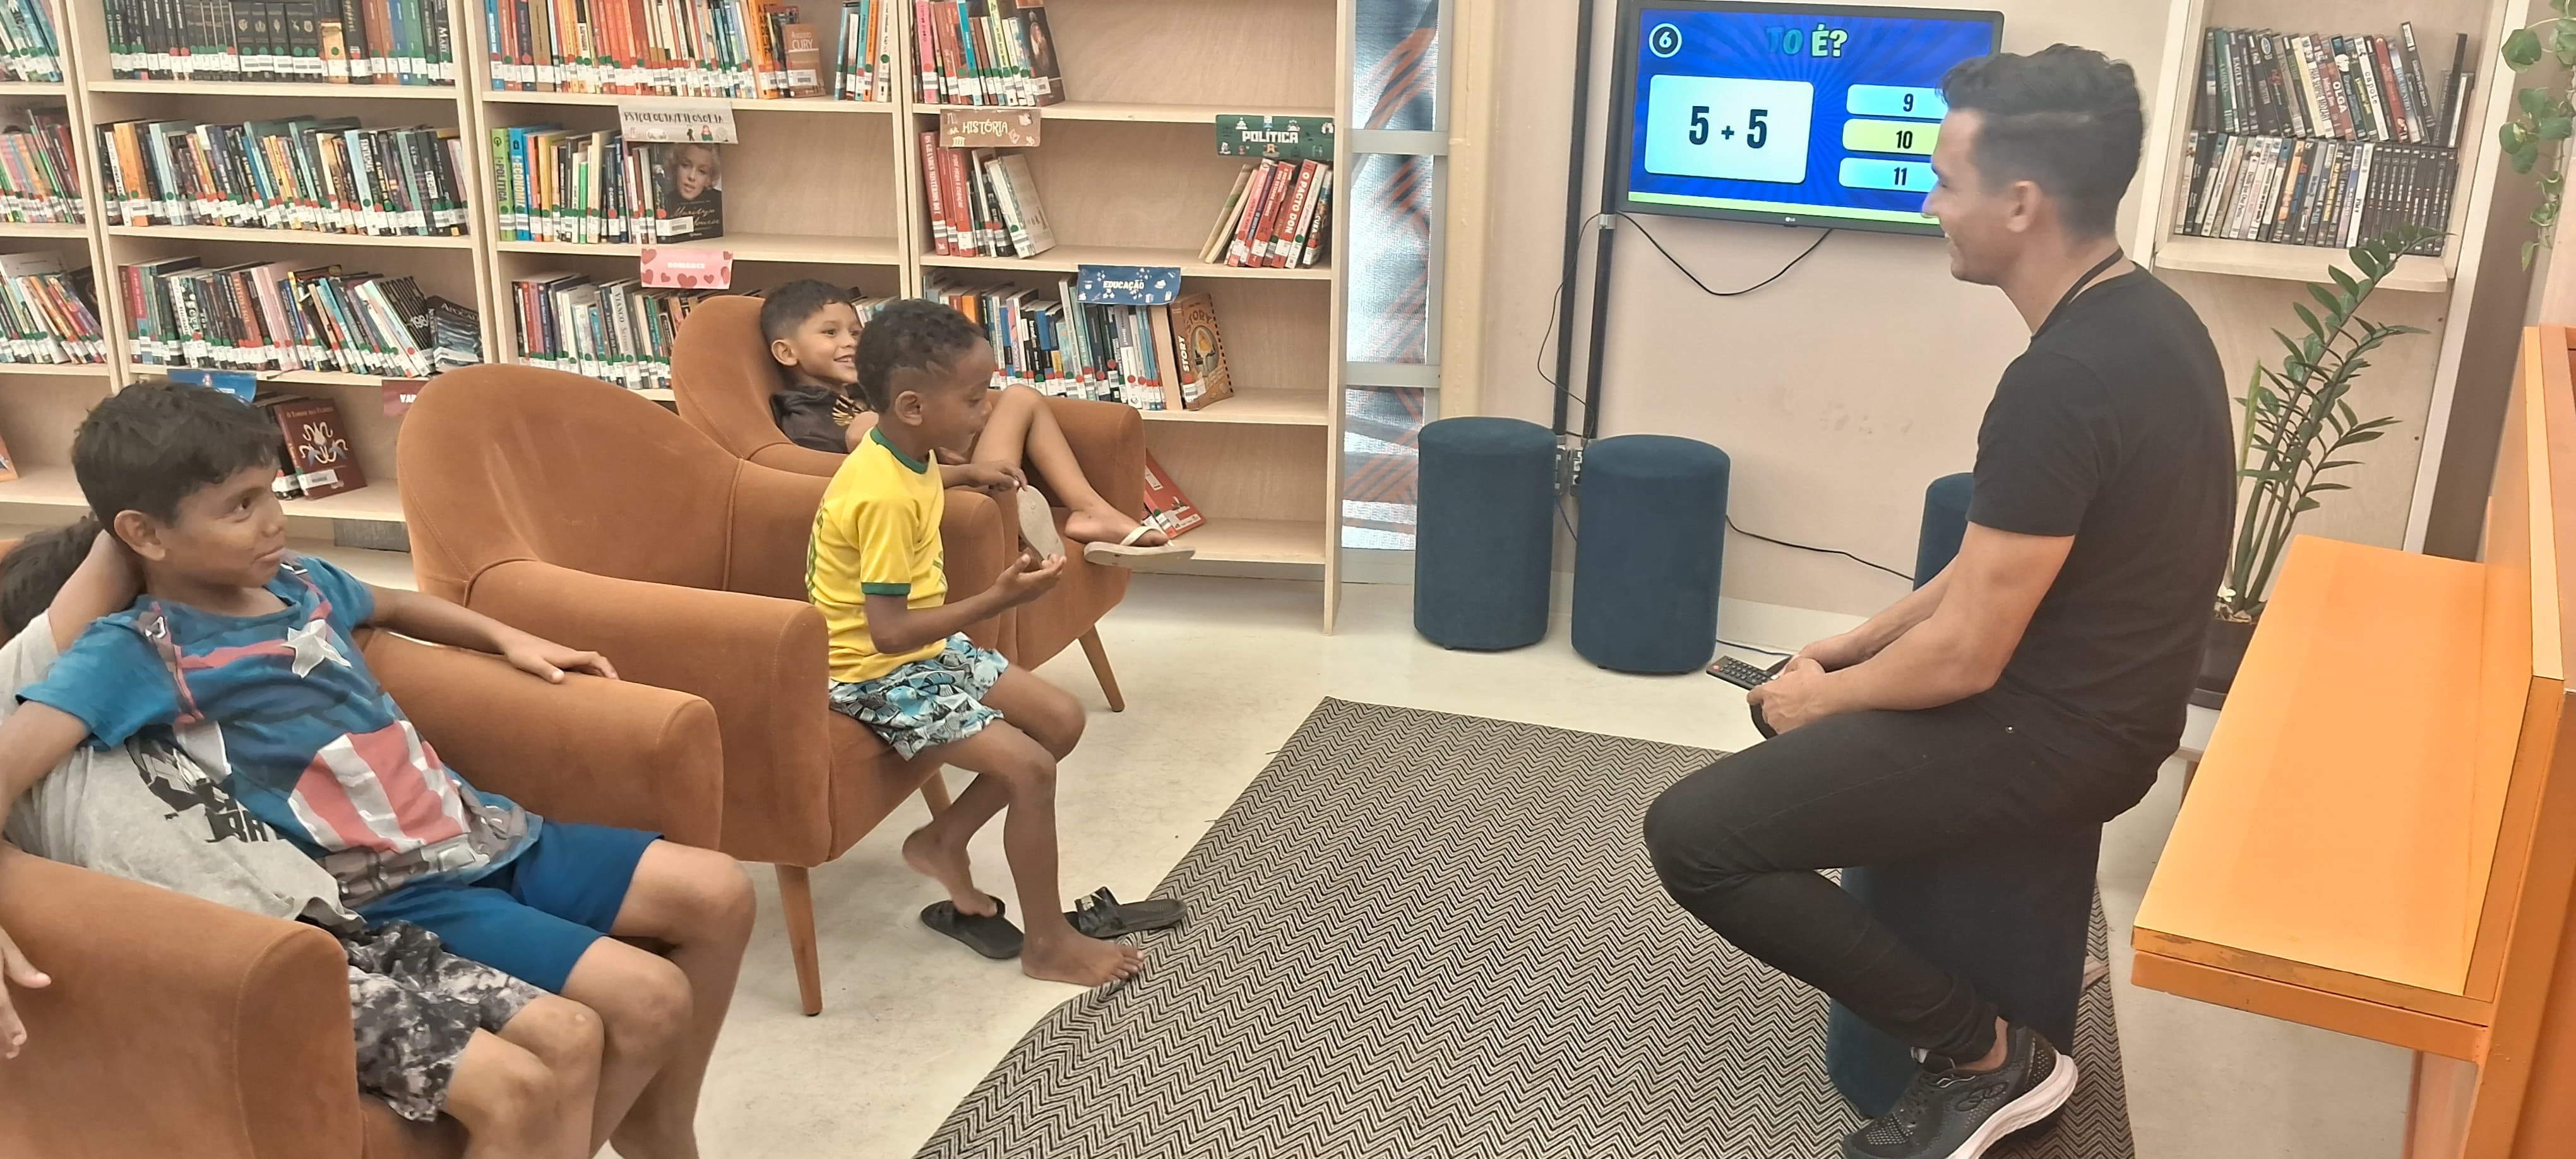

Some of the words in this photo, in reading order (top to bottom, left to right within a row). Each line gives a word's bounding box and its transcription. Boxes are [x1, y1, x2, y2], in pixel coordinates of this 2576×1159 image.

[792, 39, 813, 50] CURY
[1659, 32, 1672, 48] 6
[1810, 22, 1848, 57] É?
[2233, 57, 2243, 86] EAGLES
[2332, 80, 2348, 114] OLGA
[2363, 71, 2379, 105] capote
[1903, 93, 1914, 112] 9
[2317, 98, 2331, 122] MOZART
[962, 119, 1008, 136] HISTÓRIA
[1242, 129, 1299, 143] POLÍTICA
[1689, 105, 1710, 145] 5
[1721, 126, 1734, 140] +
[1746, 109, 1768, 148] 5
[1896, 130, 1913, 149] 10
[1301, 170, 1311, 180] O
[1894, 167, 1907, 186] 11
[1289, 180, 1310, 212] PACTO
[1309, 214, 1323, 234] CUBA
[1103, 279, 1145, 290] EDUCAÇÃO
[614, 293, 626, 323] VIANCO
[1186, 309, 1213, 334] STORY
[1178, 335, 1190, 372] STORY
